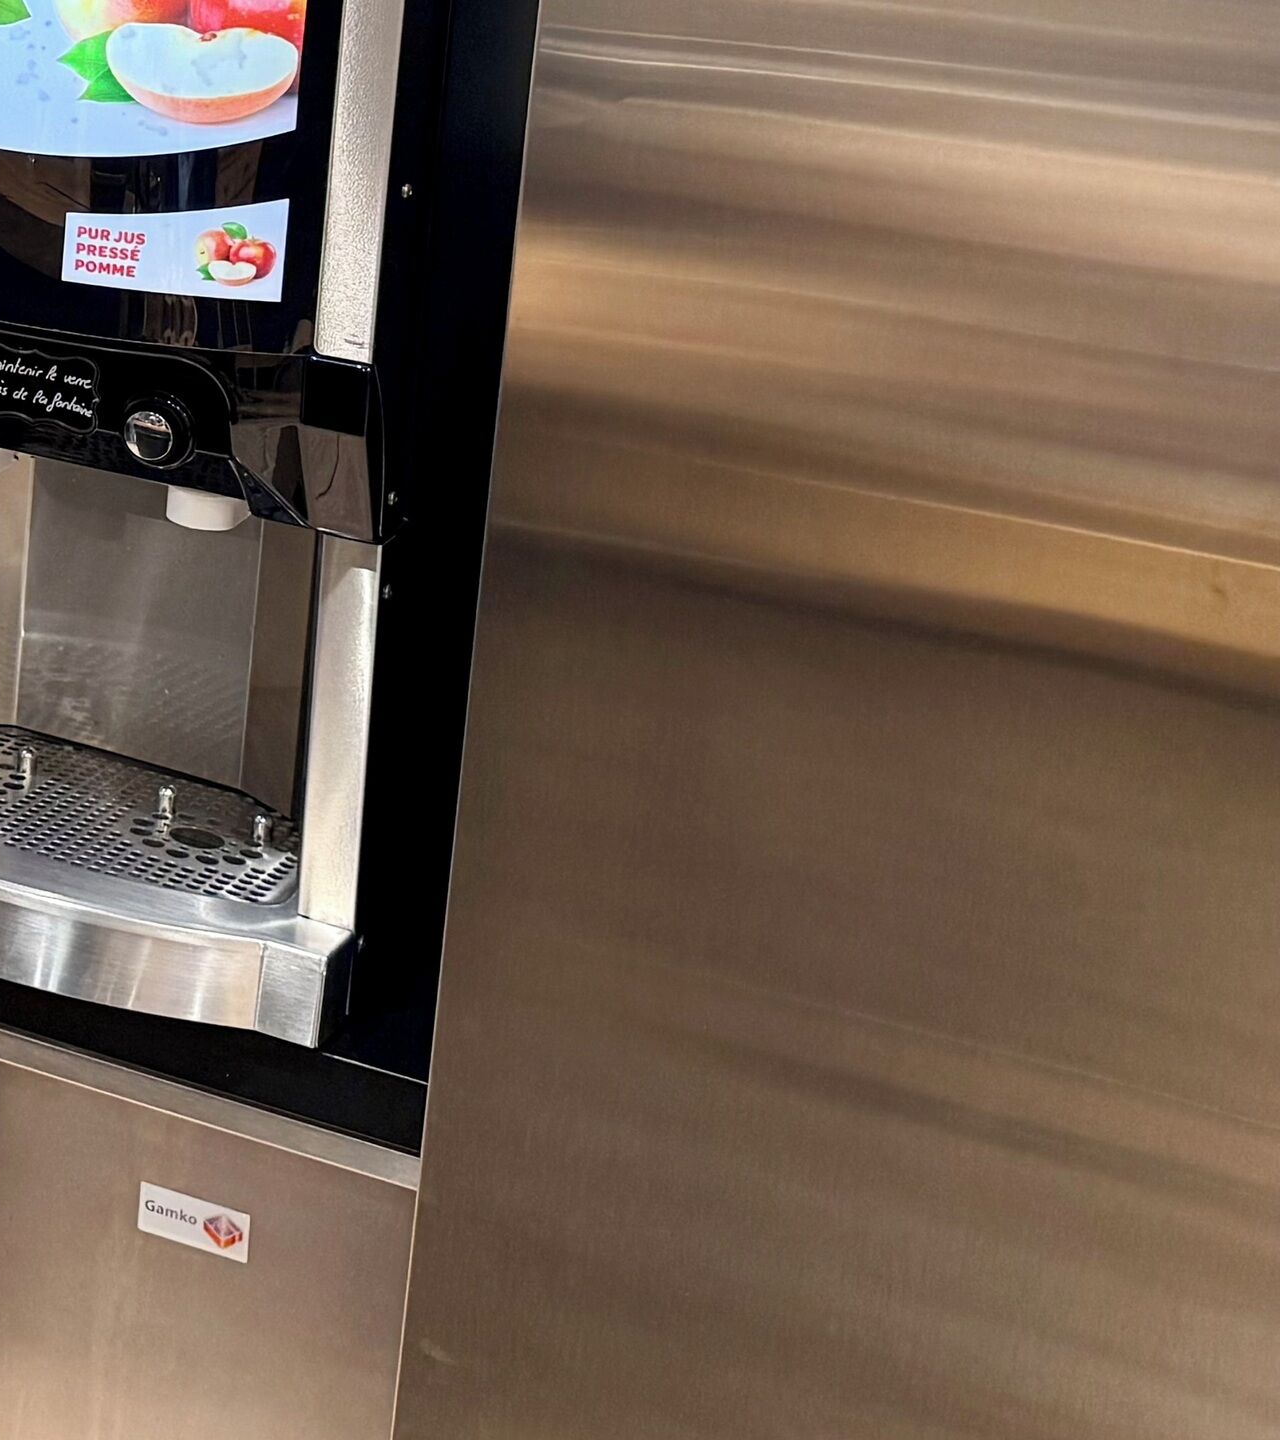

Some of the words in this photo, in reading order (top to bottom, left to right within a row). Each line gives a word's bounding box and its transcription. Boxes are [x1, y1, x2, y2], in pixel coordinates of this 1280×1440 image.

[77, 226, 111, 241] PUR
[114, 231, 146, 245] JUS
[76, 242, 141, 262] PRESSÉ
[75, 259, 136, 278] POMME
[45, 365, 58, 381] le
[63, 375, 93, 389] verre
[12, 387, 28, 400] de
[32, 390, 49, 405] la
[46, 392, 93, 418] fontaine
[144, 1199, 198, 1225] Gamko
